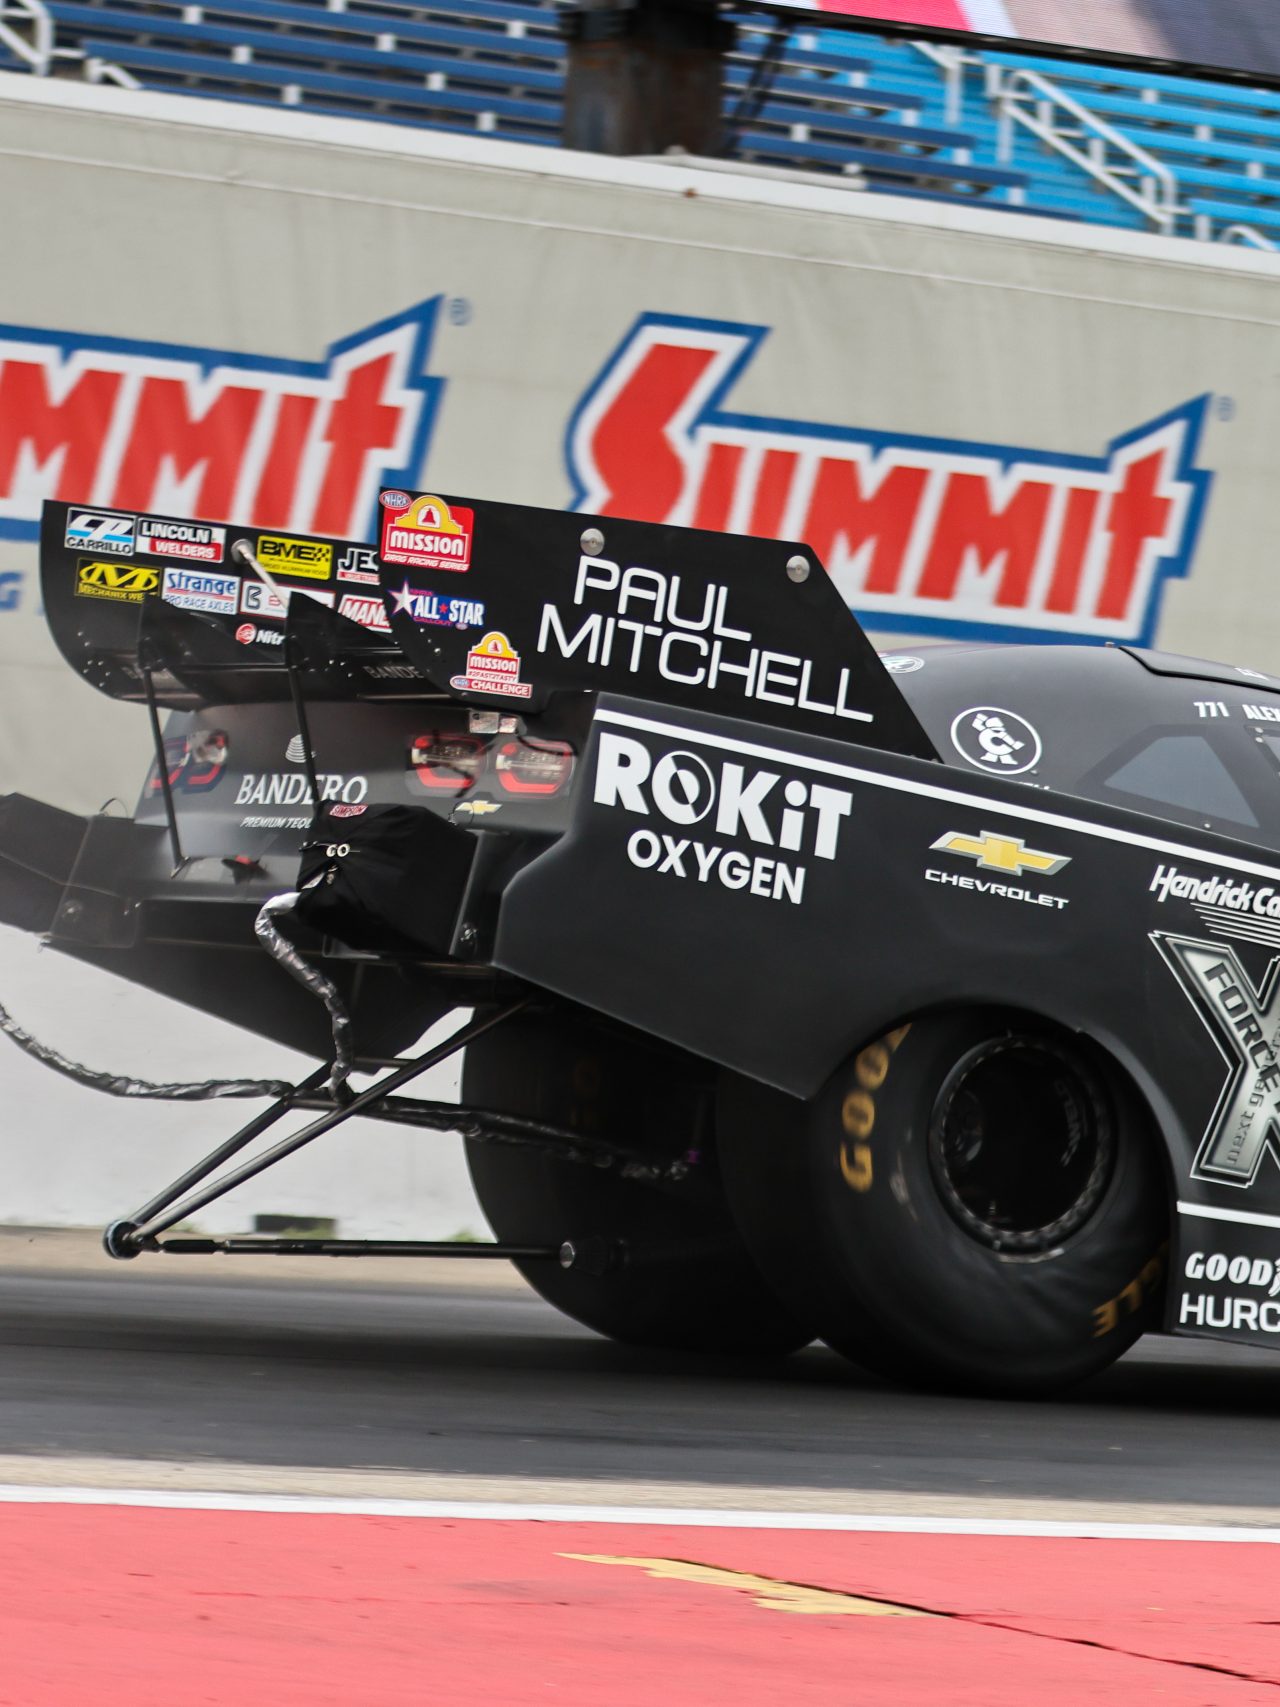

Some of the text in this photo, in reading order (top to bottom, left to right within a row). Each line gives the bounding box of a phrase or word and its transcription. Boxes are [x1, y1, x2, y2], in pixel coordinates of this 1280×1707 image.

[142, 521, 210, 543] LINCOLN
[67, 537, 132, 554] CARRILLO
[155, 541, 215, 559] WELDERS
[261, 540, 315, 562] BME
[128, 592, 145, 602] WE
[574, 555, 752, 641] PAUL
[414, 595, 485, 626] ALL STAR
[255, 630, 285, 645] Nitr
[537, 603, 874, 722] MITCHELL
[363, 665, 424, 679] BANDE
[471, 680, 528, 696] CHALLENGE
[1194, 701, 1230, 718] 771
[240, 816, 286, 828] PREMIUM
[626, 829, 806, 906] OXYGEN
[924, 869, 1070, 910] CHEVROLET
